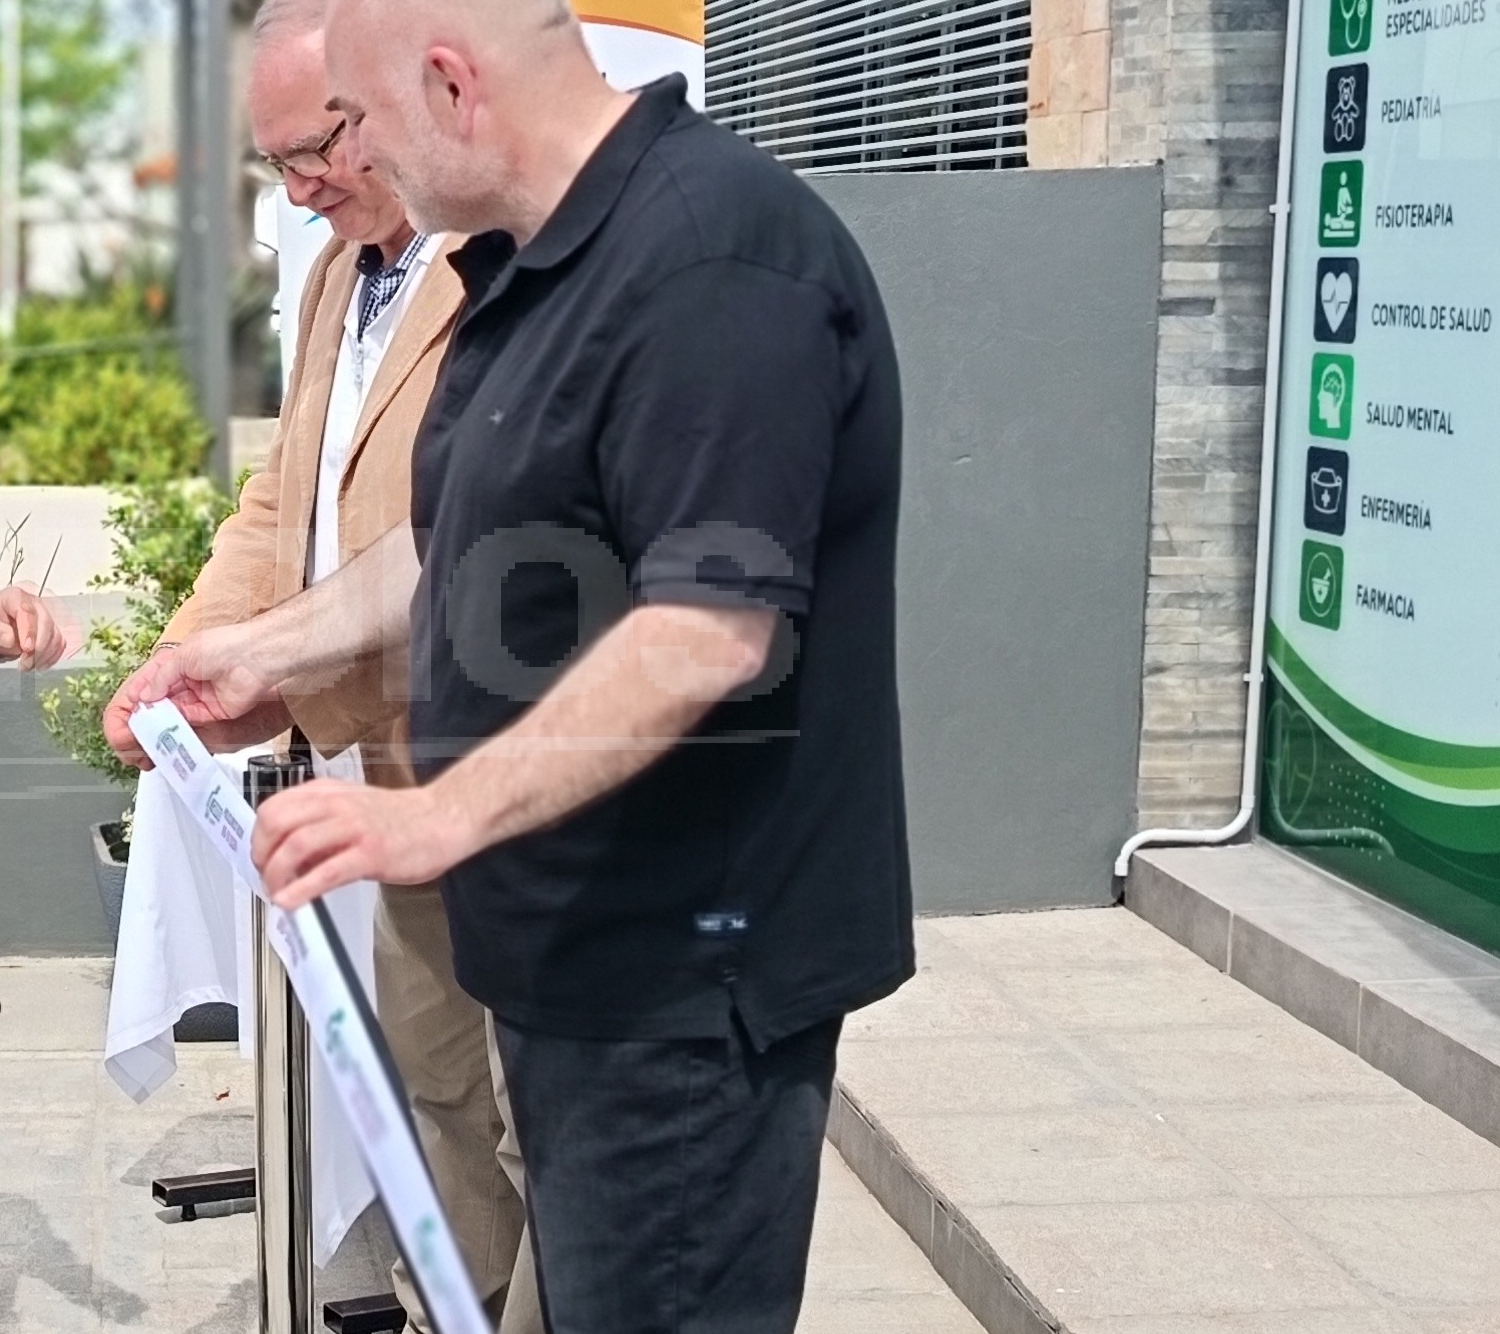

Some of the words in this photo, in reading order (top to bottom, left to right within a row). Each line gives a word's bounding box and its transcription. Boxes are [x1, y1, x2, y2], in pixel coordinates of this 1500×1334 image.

[1381, 89, 1442, 124] PEDIATRÍA
[1375, 203, 1454, 229] FISIOTERAPIA
[1372, 303, 1427, 329] CONTROL
[1430, 305, 1446, 330] DE
[1449, 306, 1492, 333] SALUD
[1366, 401, 1403, 428] SALUD
[1406, 407, 1454, 435] MENTAL
[1360, 495, 1433, 531] ENFERMERÍA
[1356, 584, 1415, 621] FARMACIA
